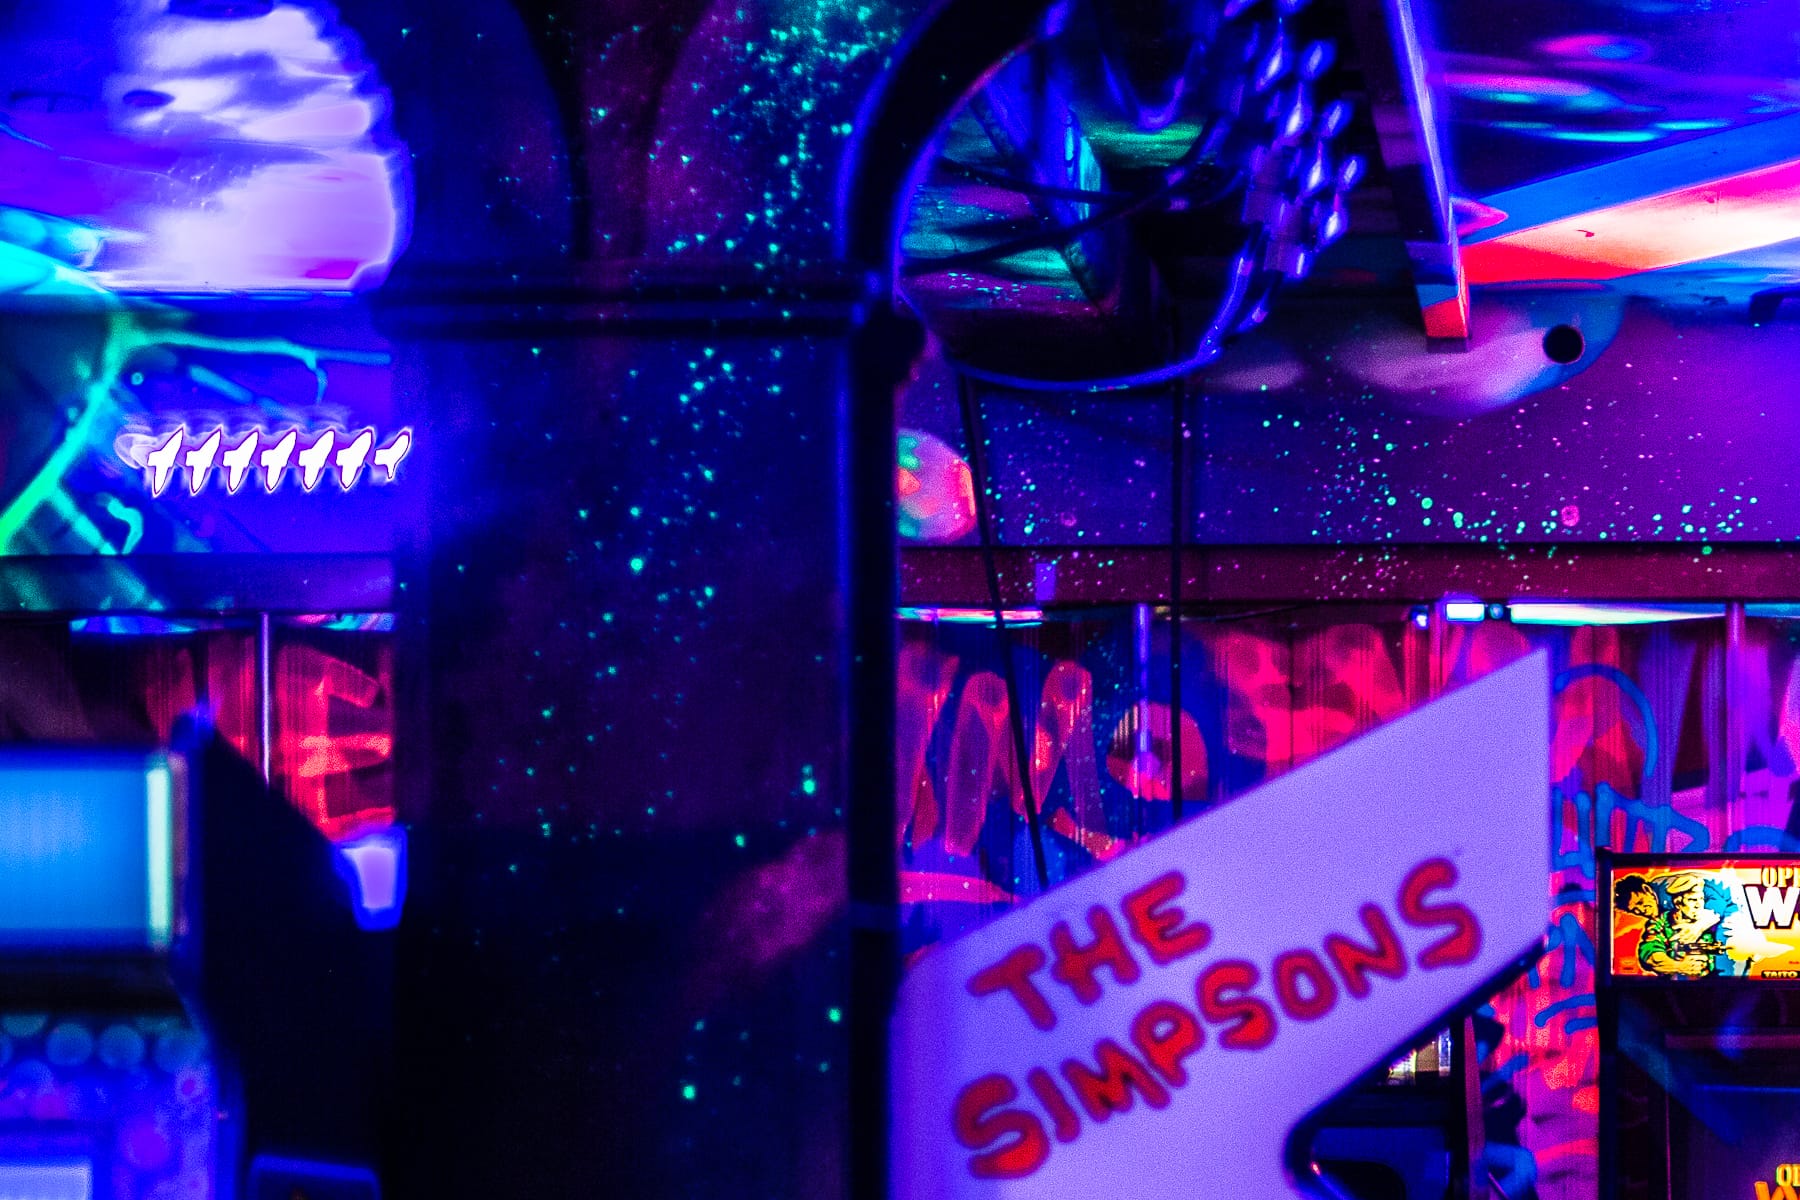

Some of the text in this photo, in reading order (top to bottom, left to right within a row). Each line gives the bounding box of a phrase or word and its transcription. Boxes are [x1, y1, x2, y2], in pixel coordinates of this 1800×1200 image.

[951, 856, 1485, 1179] SIMPSONS
[967, 871, 1213, 1032] THE
[1763, 970, 1799, 979] TAITO
